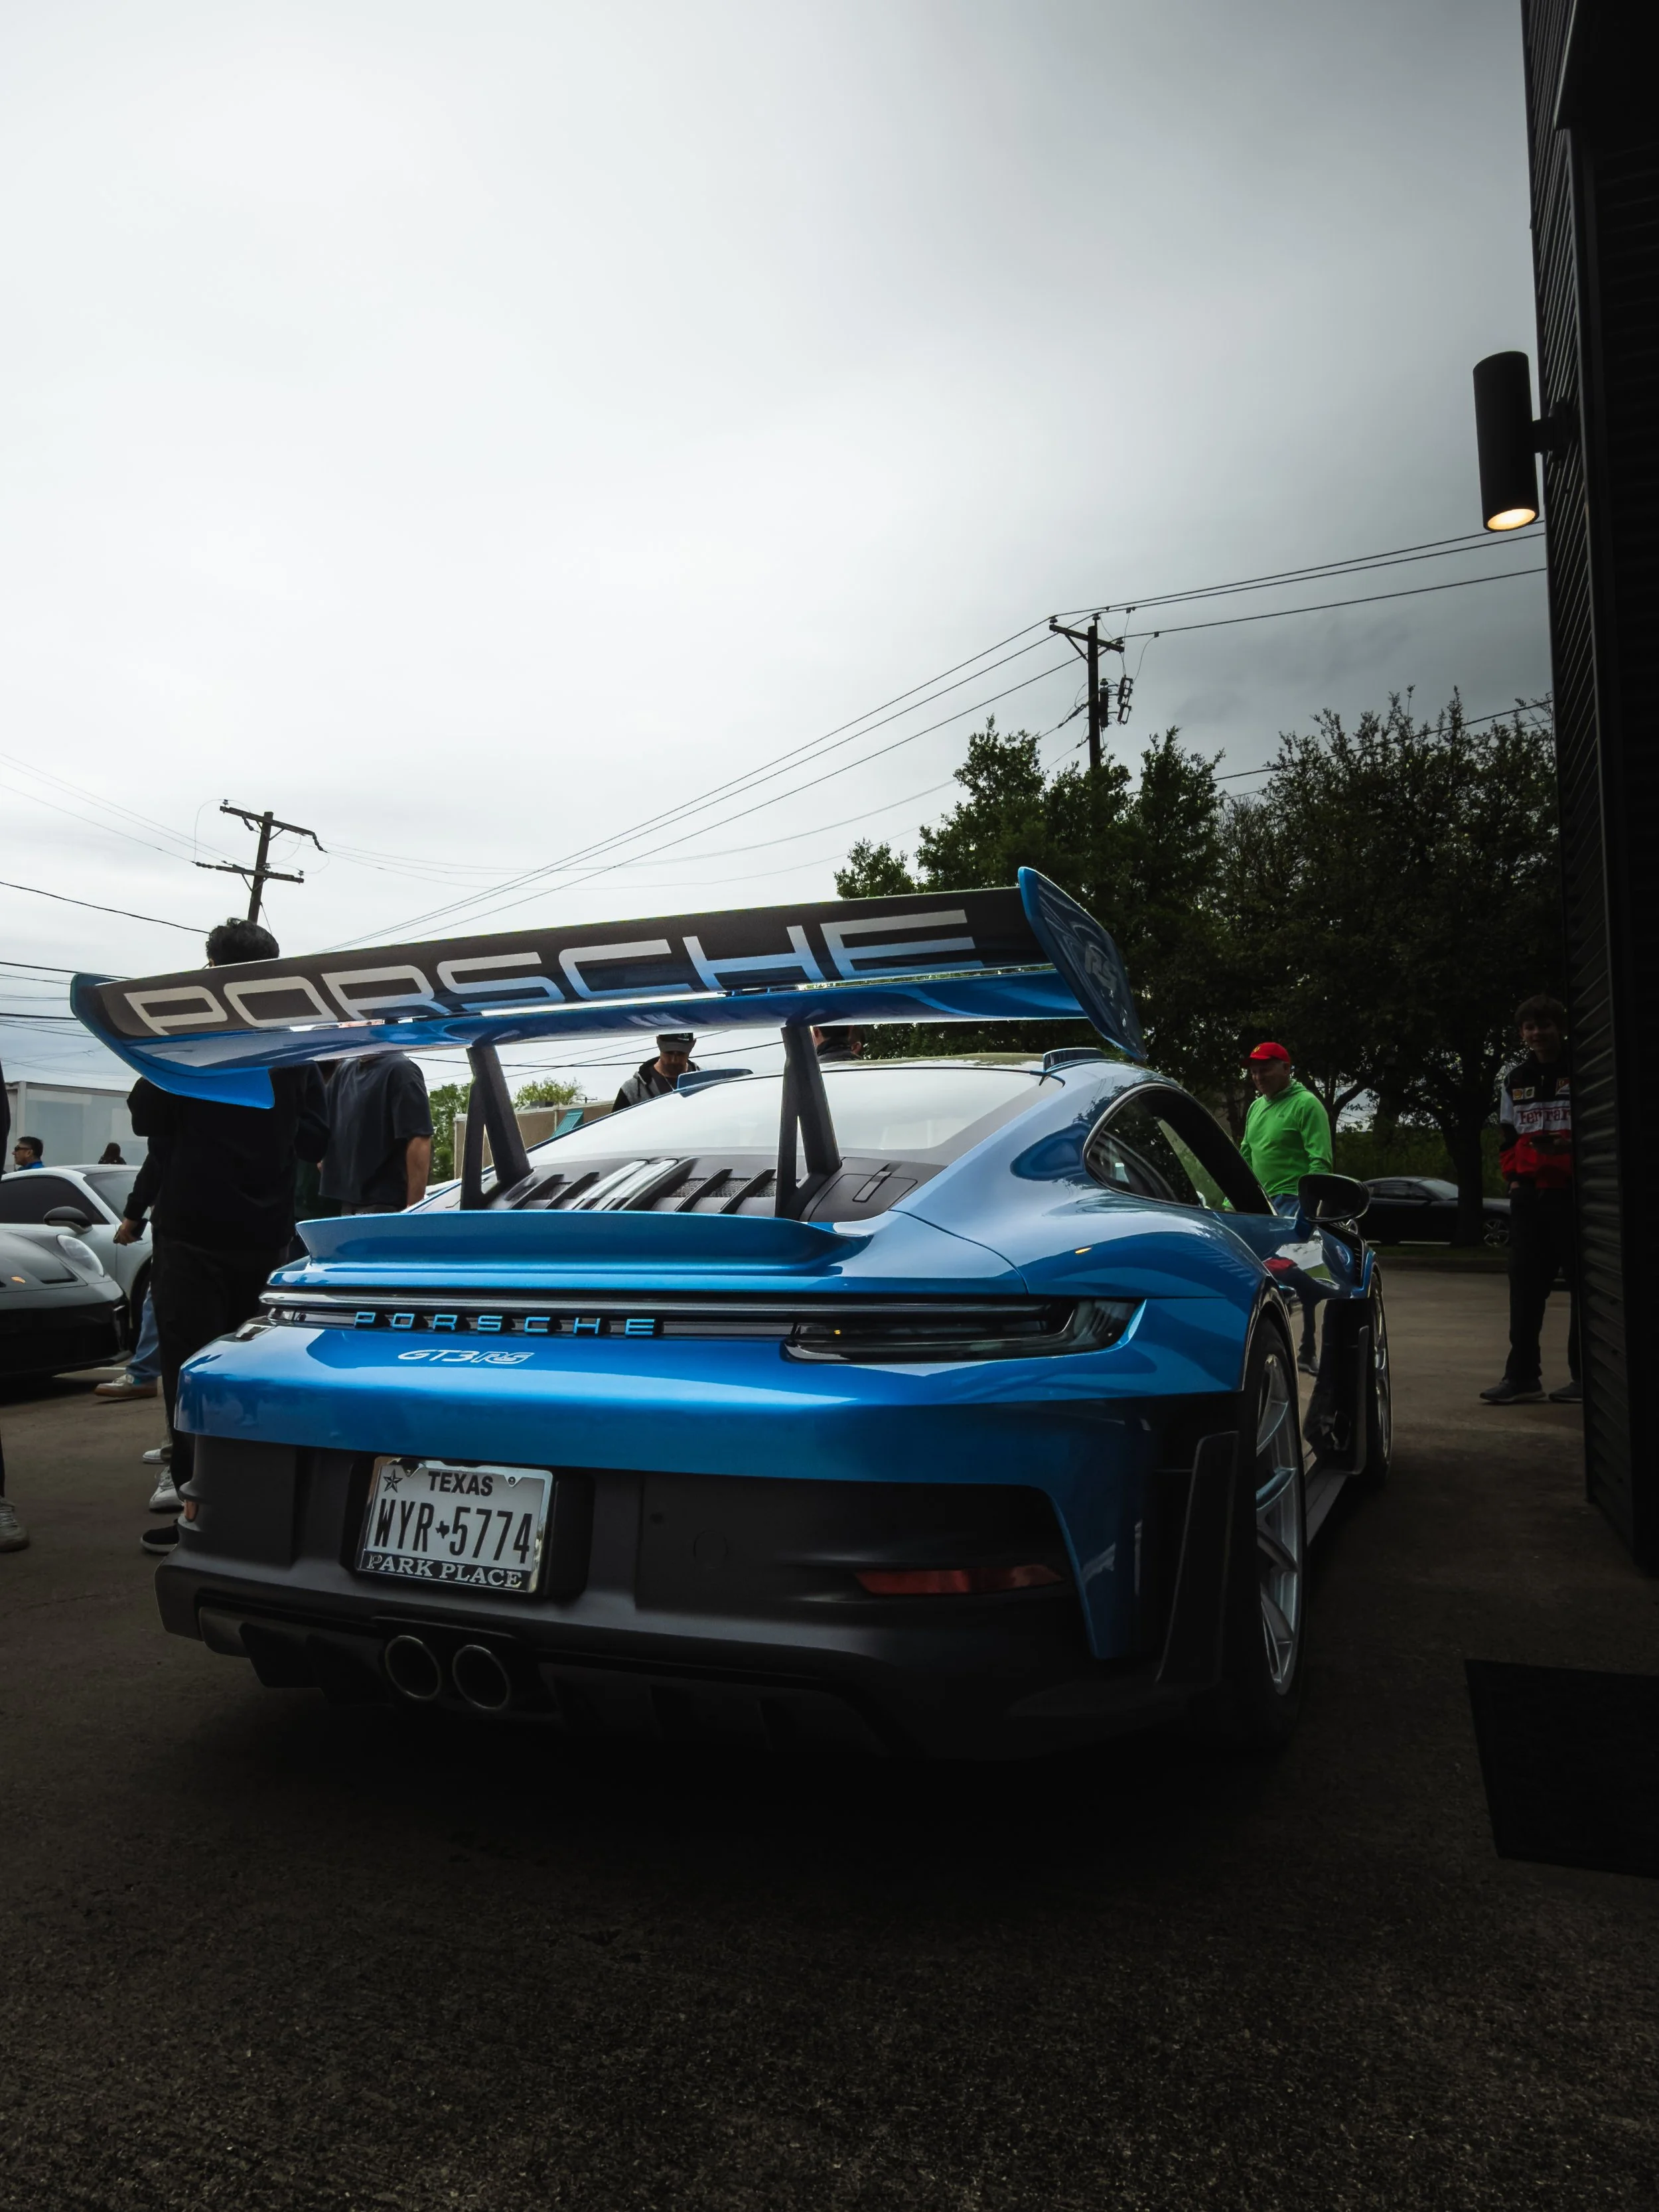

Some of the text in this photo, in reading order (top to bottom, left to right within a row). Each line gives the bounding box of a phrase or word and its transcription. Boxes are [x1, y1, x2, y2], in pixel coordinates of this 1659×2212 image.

[123, 909, 984, 1035] PORSCHE
[1517, 1106, 1570, 1125] Ferrar
[354, 1311, 656, 1335] PORSCHE
[428, 1470, 494, 1497] TEXAS
[366, 1552, 523, 1588] PARK PLACE
